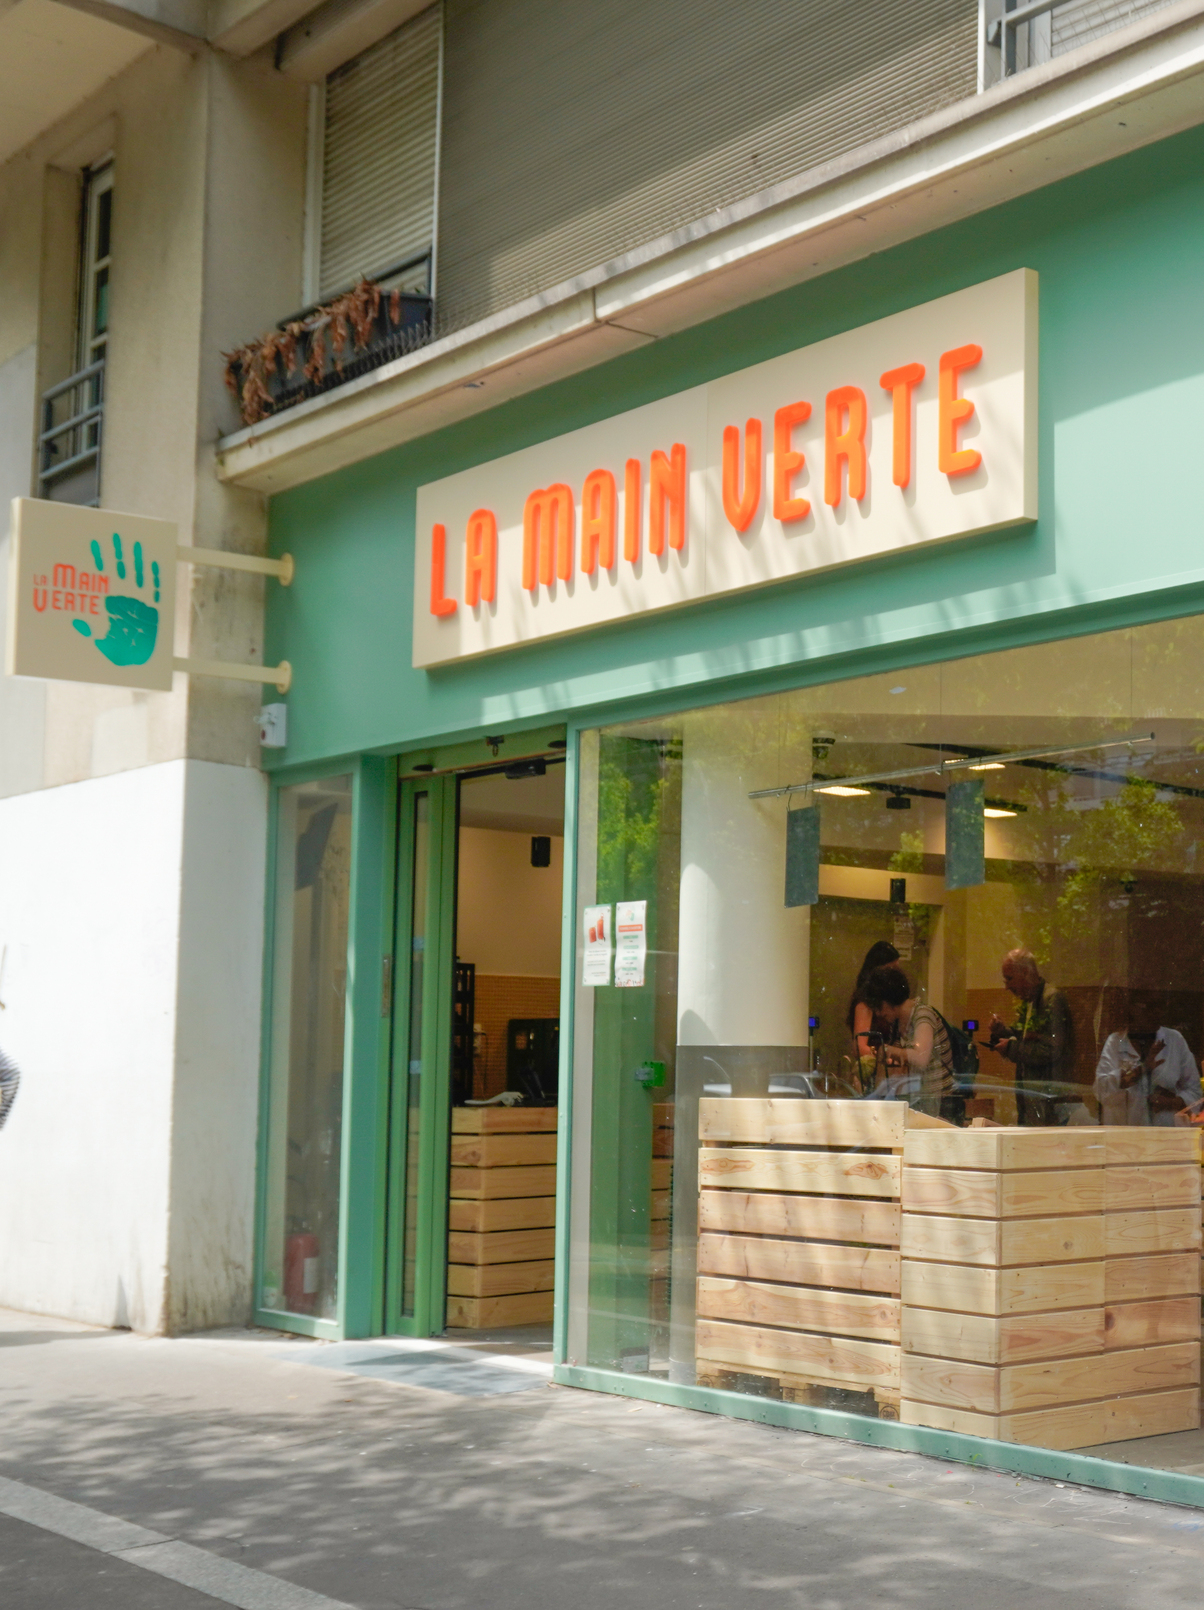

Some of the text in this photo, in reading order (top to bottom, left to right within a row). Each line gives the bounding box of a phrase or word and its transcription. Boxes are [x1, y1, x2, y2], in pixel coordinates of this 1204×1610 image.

[430, 343, 984, 618] LA MAIN VERTE
